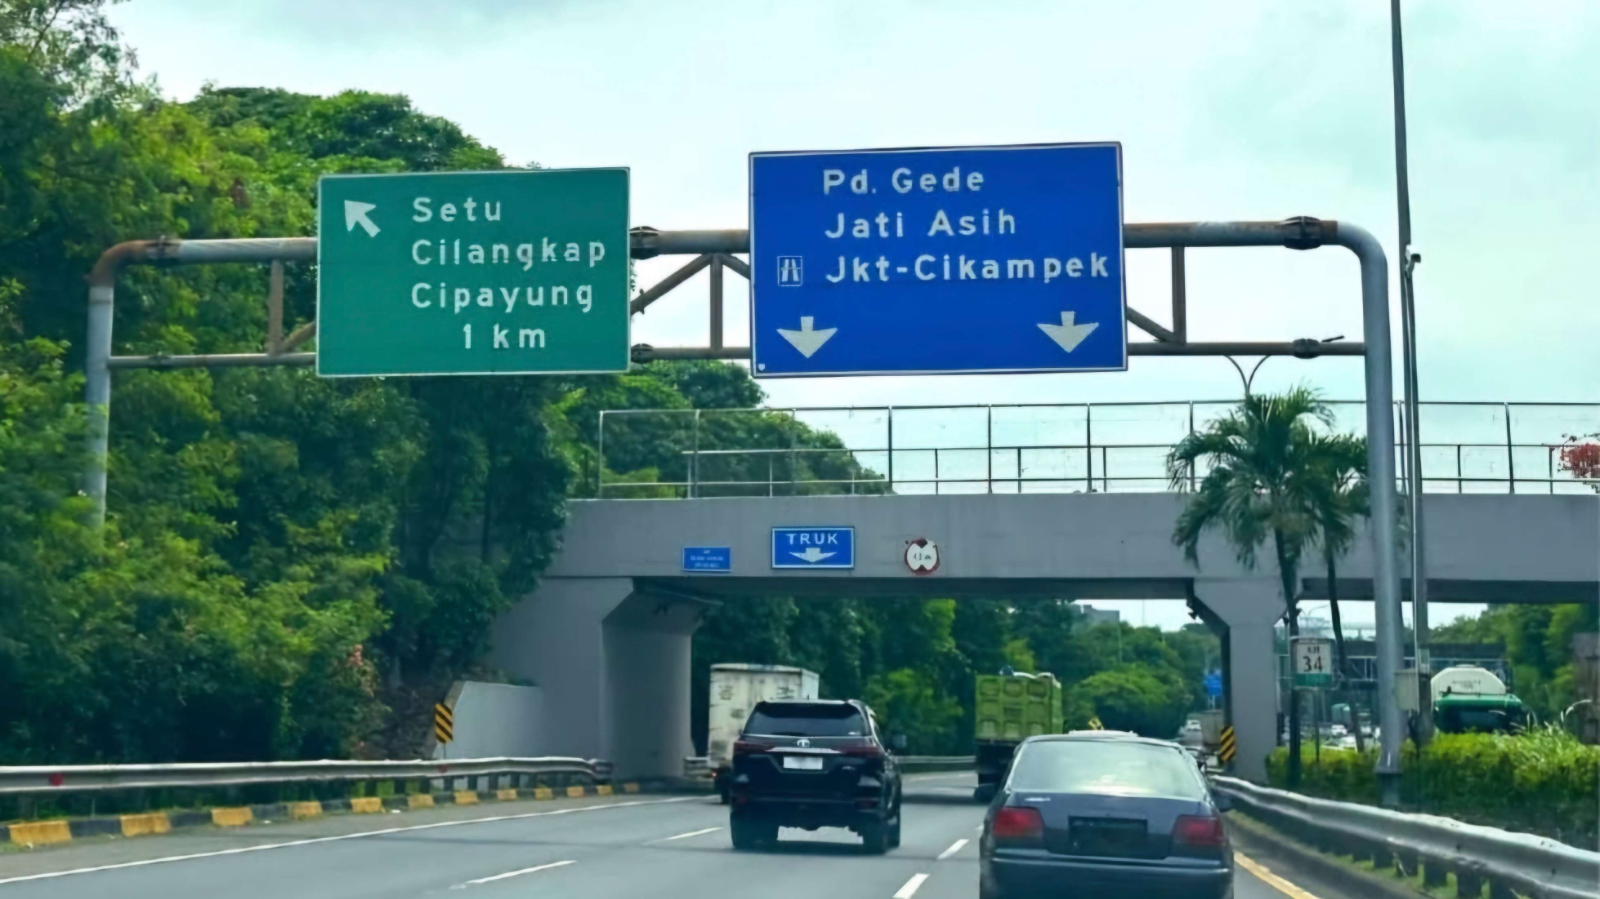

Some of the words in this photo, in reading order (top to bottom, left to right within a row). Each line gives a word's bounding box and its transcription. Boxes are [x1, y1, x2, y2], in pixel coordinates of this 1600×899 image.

[823, 168, 878, 195] Pd.
[892, 167, 985, 195] Gede
[412, 197, 502, 223] Setu
[825, 211, 905, 240] Jati
[927, 209, 1017, 237] Asih
[411, 236, 606, 272] Cilangkap
[825, 252, 1110, 284] Jkt-Cikampek
[411, 282, 594, 315] Cipayung
[463, 323, 473, 350] 1
[493, 323, 546, 350] km
[786, 532, 839, 546] TRUK
[1302, 655, 1323, 673] 34
